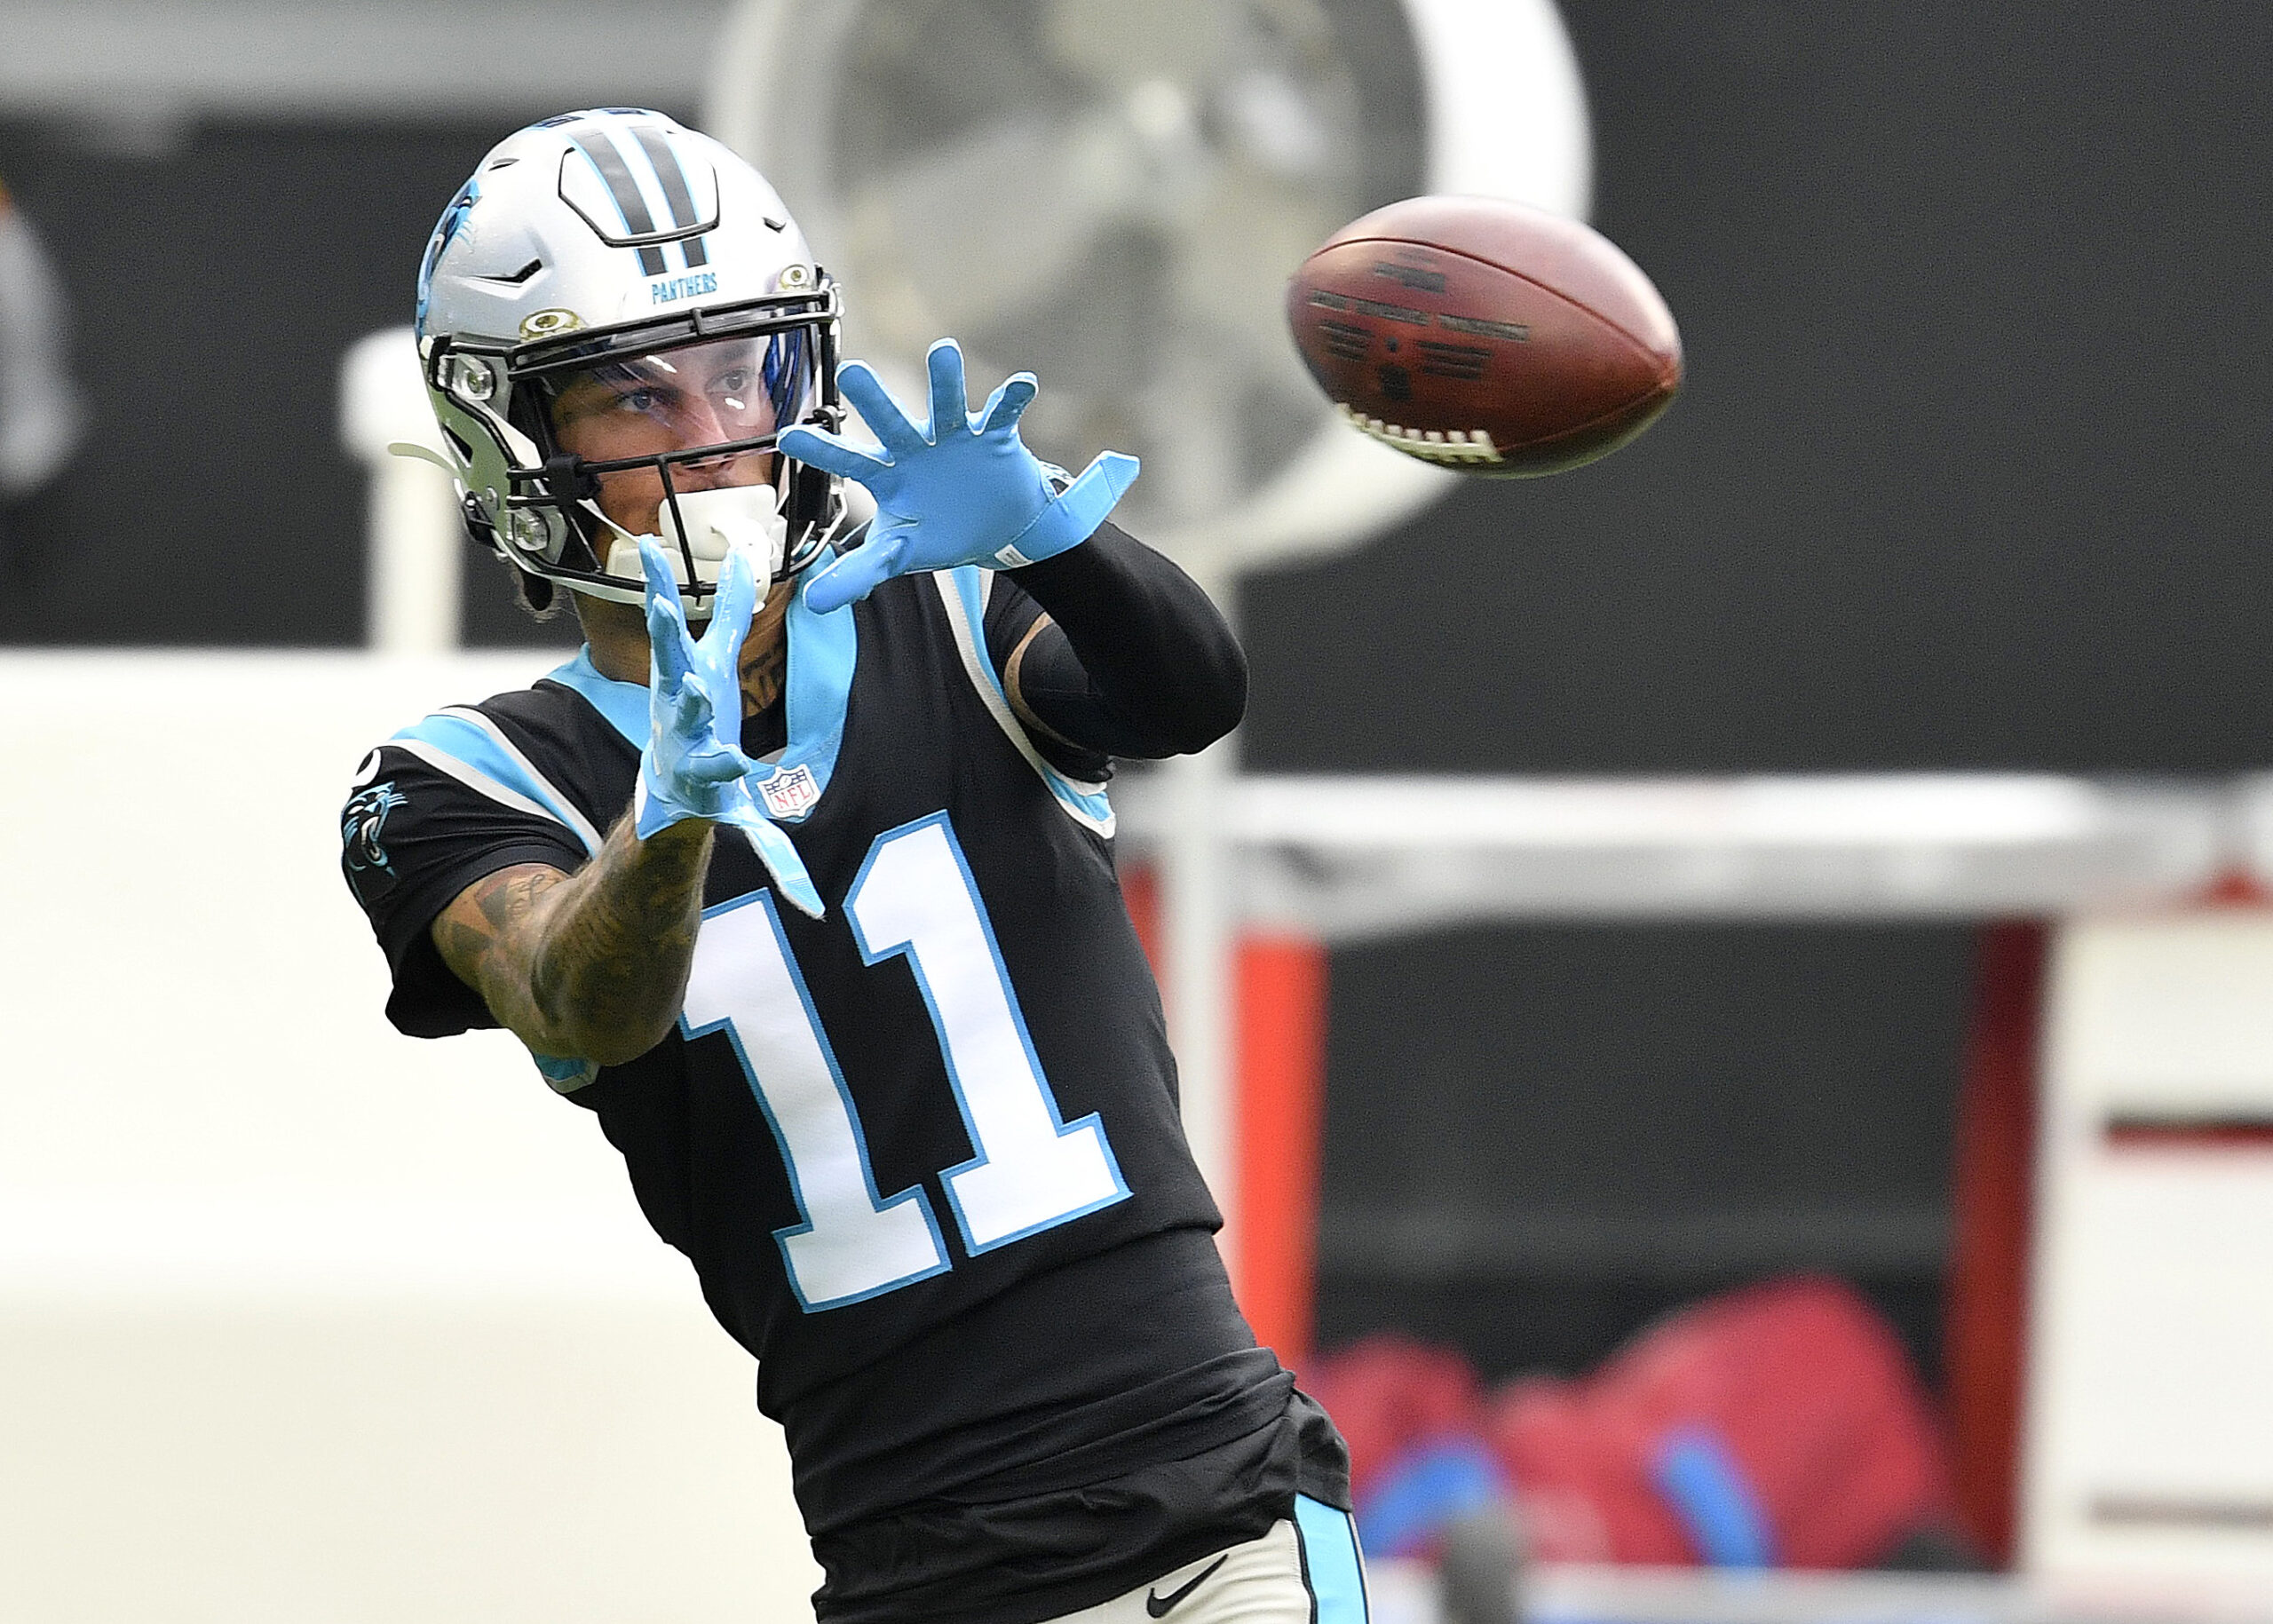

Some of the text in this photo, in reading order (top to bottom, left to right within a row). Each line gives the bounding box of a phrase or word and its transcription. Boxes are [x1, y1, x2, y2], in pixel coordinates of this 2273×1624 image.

[652, 272, 717, 305] PANTHERS
[774, 784, 811, 809] NFL
[678, 809, 1134, 1314] 11
